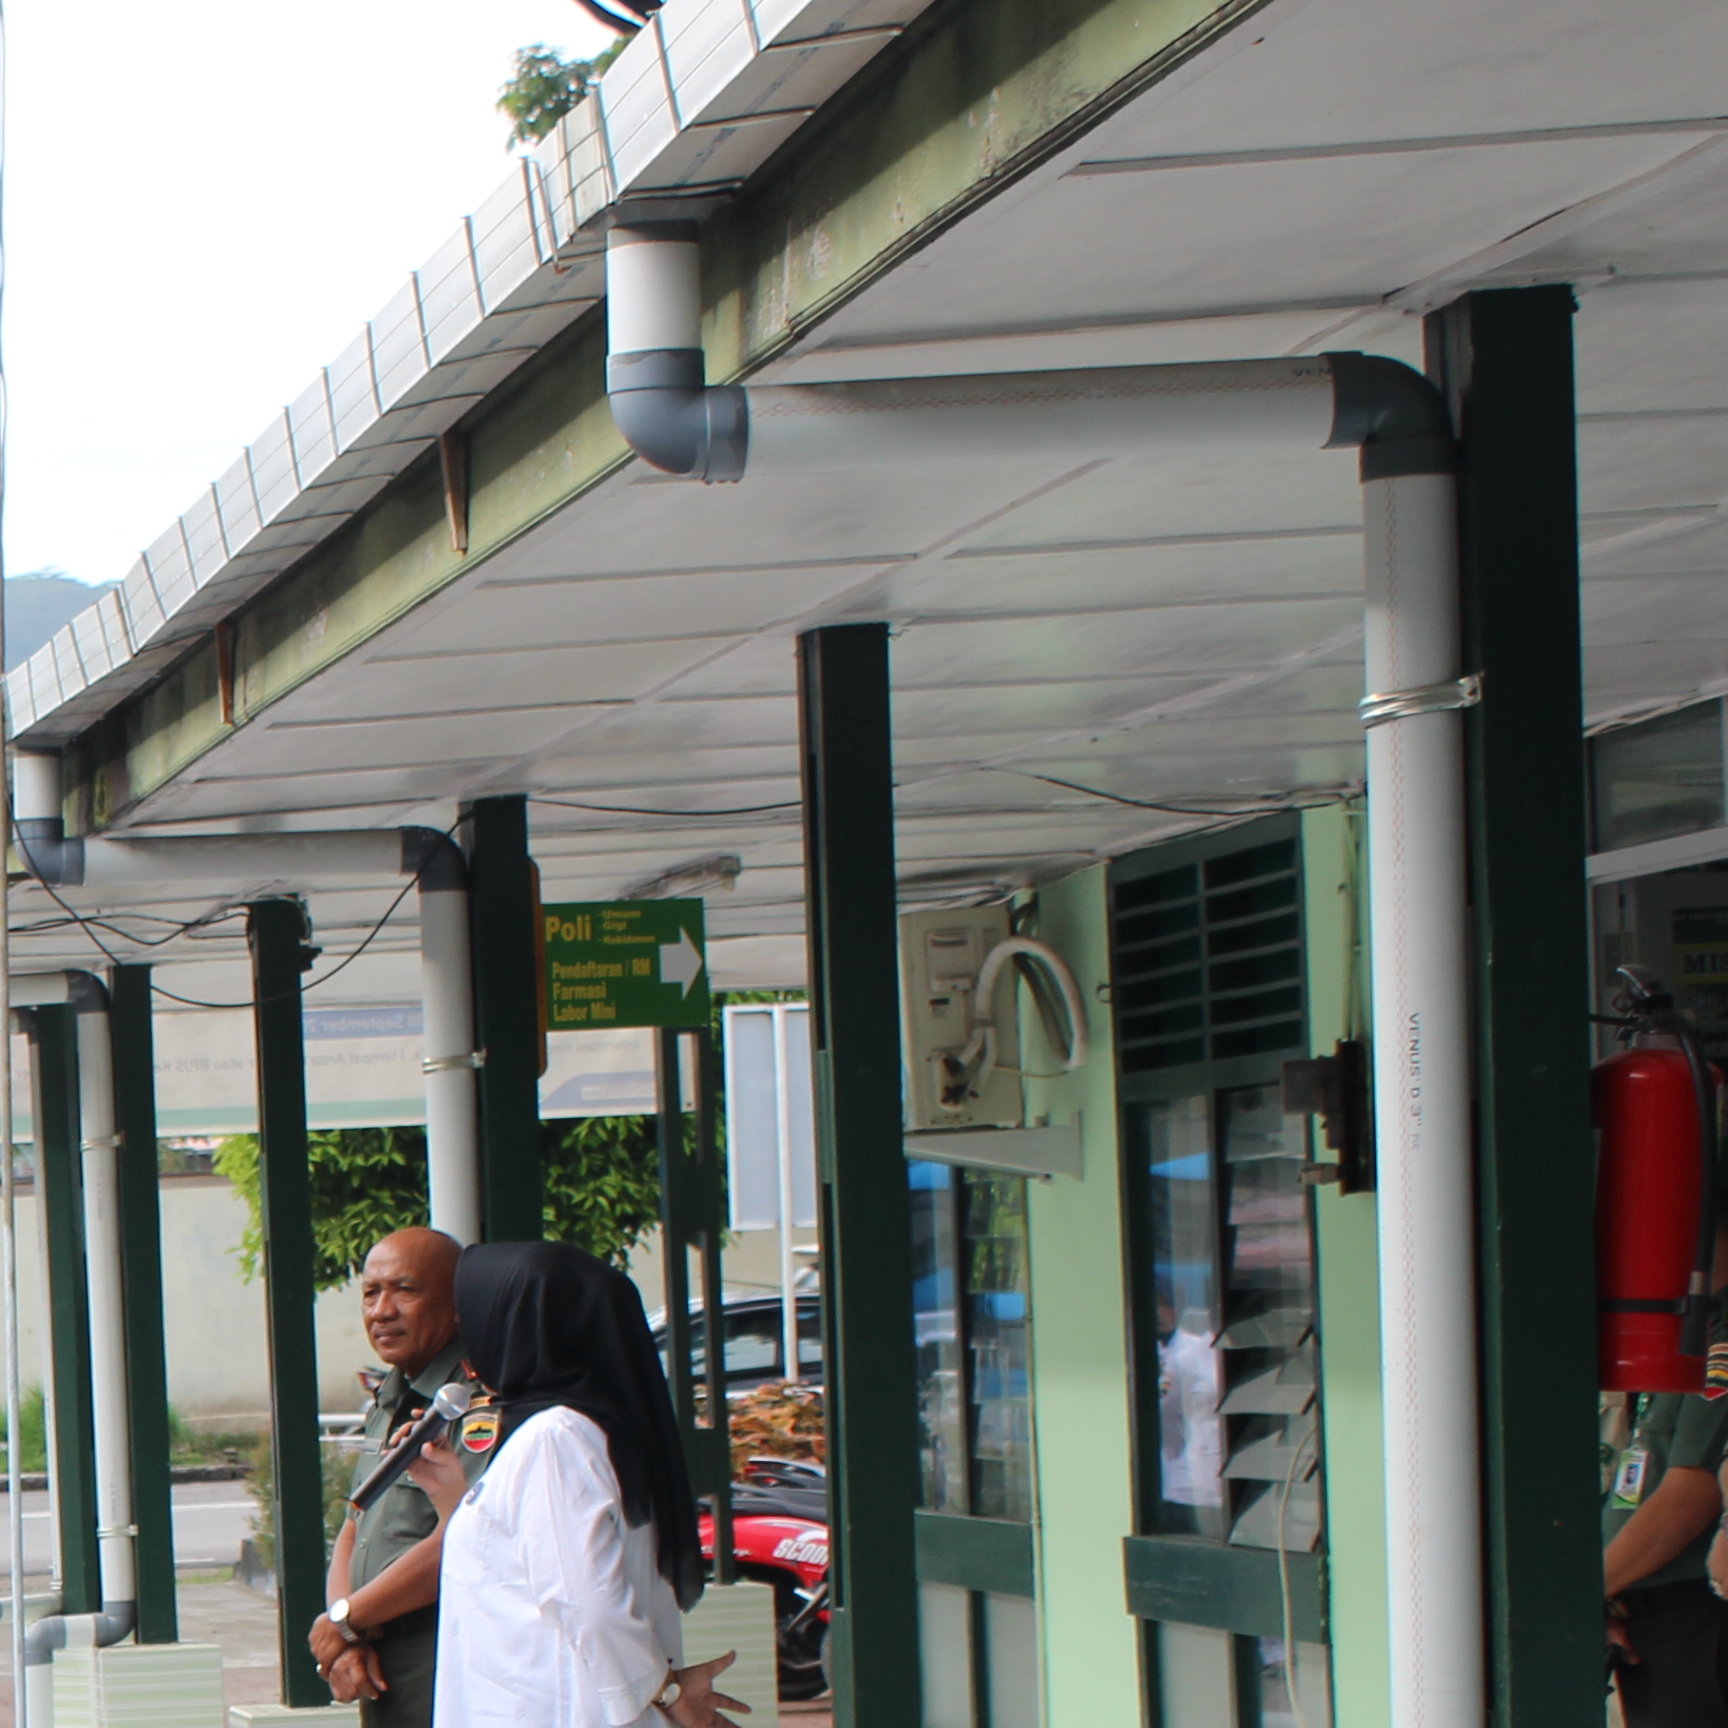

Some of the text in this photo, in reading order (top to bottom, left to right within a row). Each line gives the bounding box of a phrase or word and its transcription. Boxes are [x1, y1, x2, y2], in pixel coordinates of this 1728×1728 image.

[545, 915, 592, 943] Poli
[552, 961, 623, 979] Pendaftaran
[632, 958, 651, 976] RM
[553, 981, 607, 1001] Farmasi
[553, 1001, 616, 1022] Labor Mini
